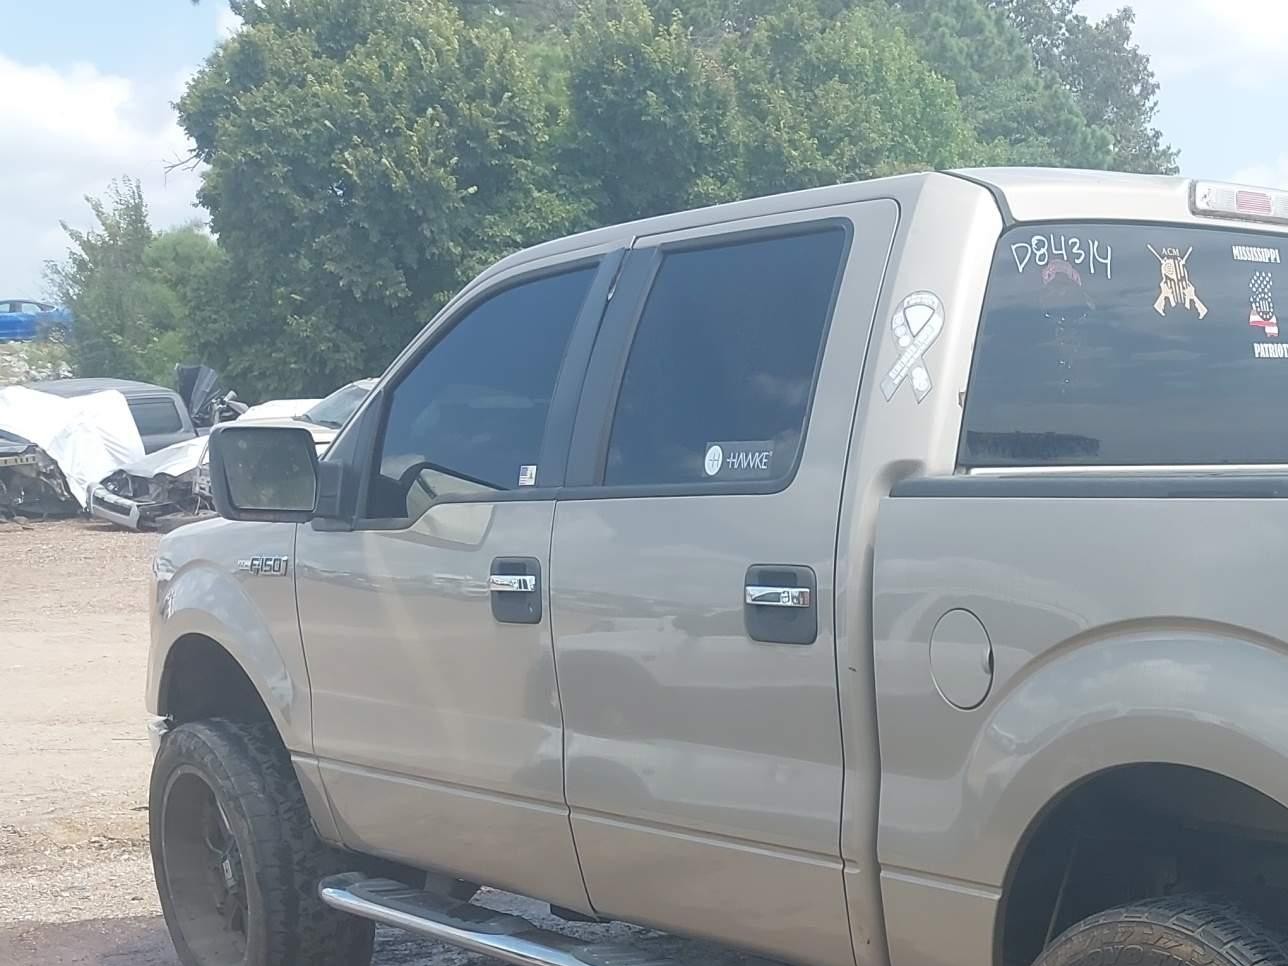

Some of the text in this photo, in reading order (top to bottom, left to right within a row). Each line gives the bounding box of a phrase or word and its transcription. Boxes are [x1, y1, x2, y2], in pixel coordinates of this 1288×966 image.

[1011, 233, 1112, 280] D84314
[1232, 245, 1281, 264] MISSISSIPPI
[726, 451, 769, 470] HAWKE
